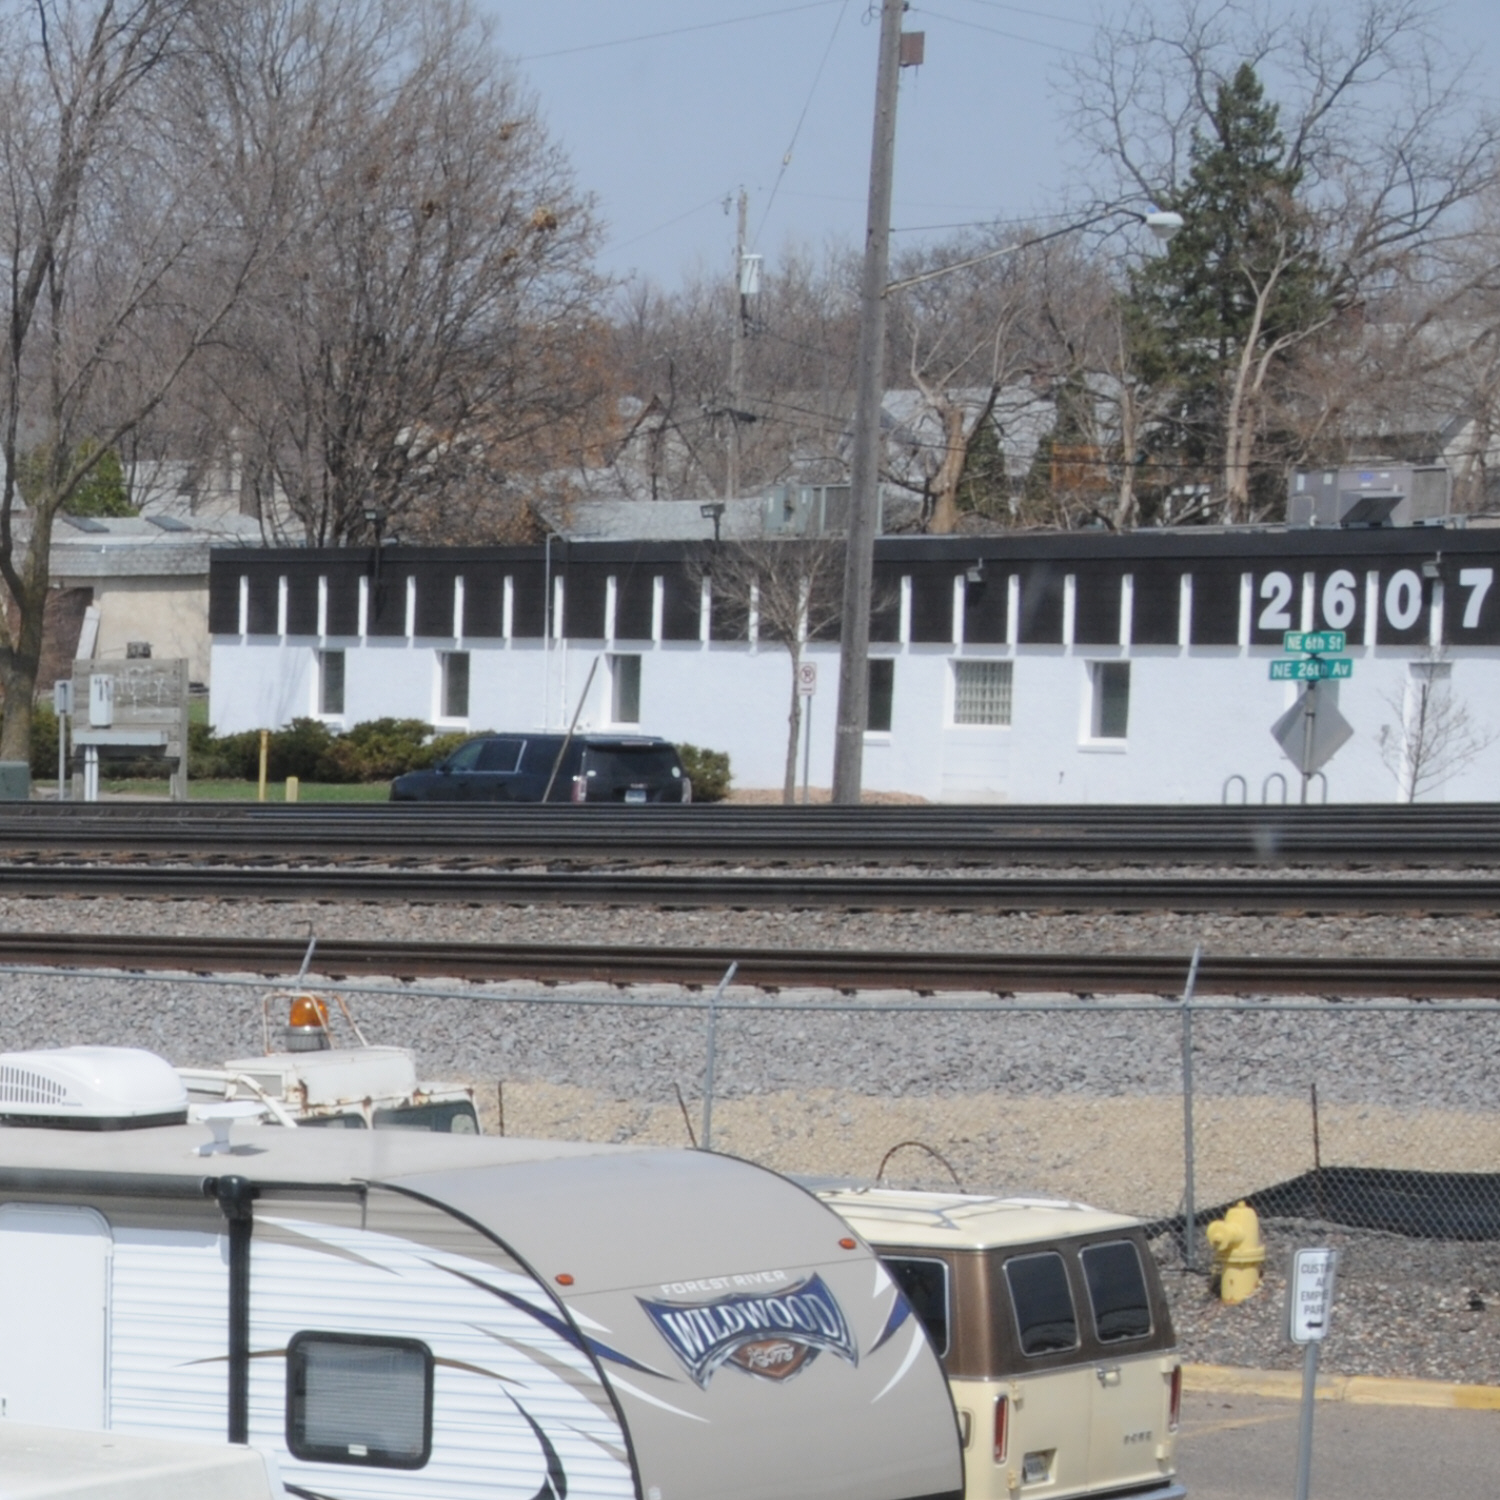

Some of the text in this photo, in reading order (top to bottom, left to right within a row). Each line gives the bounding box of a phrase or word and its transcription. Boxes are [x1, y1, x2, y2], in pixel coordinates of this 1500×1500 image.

[1258, 568, 1494, 630] 2607
[1286, 634, 1342, 651] NE 6th St
[1272, 660, 1350, 678] NE 26th Av
[660, 1269, 788, 1296] FOREST RIVER
[661, 1292, 842, 1359] WILDWOOD
